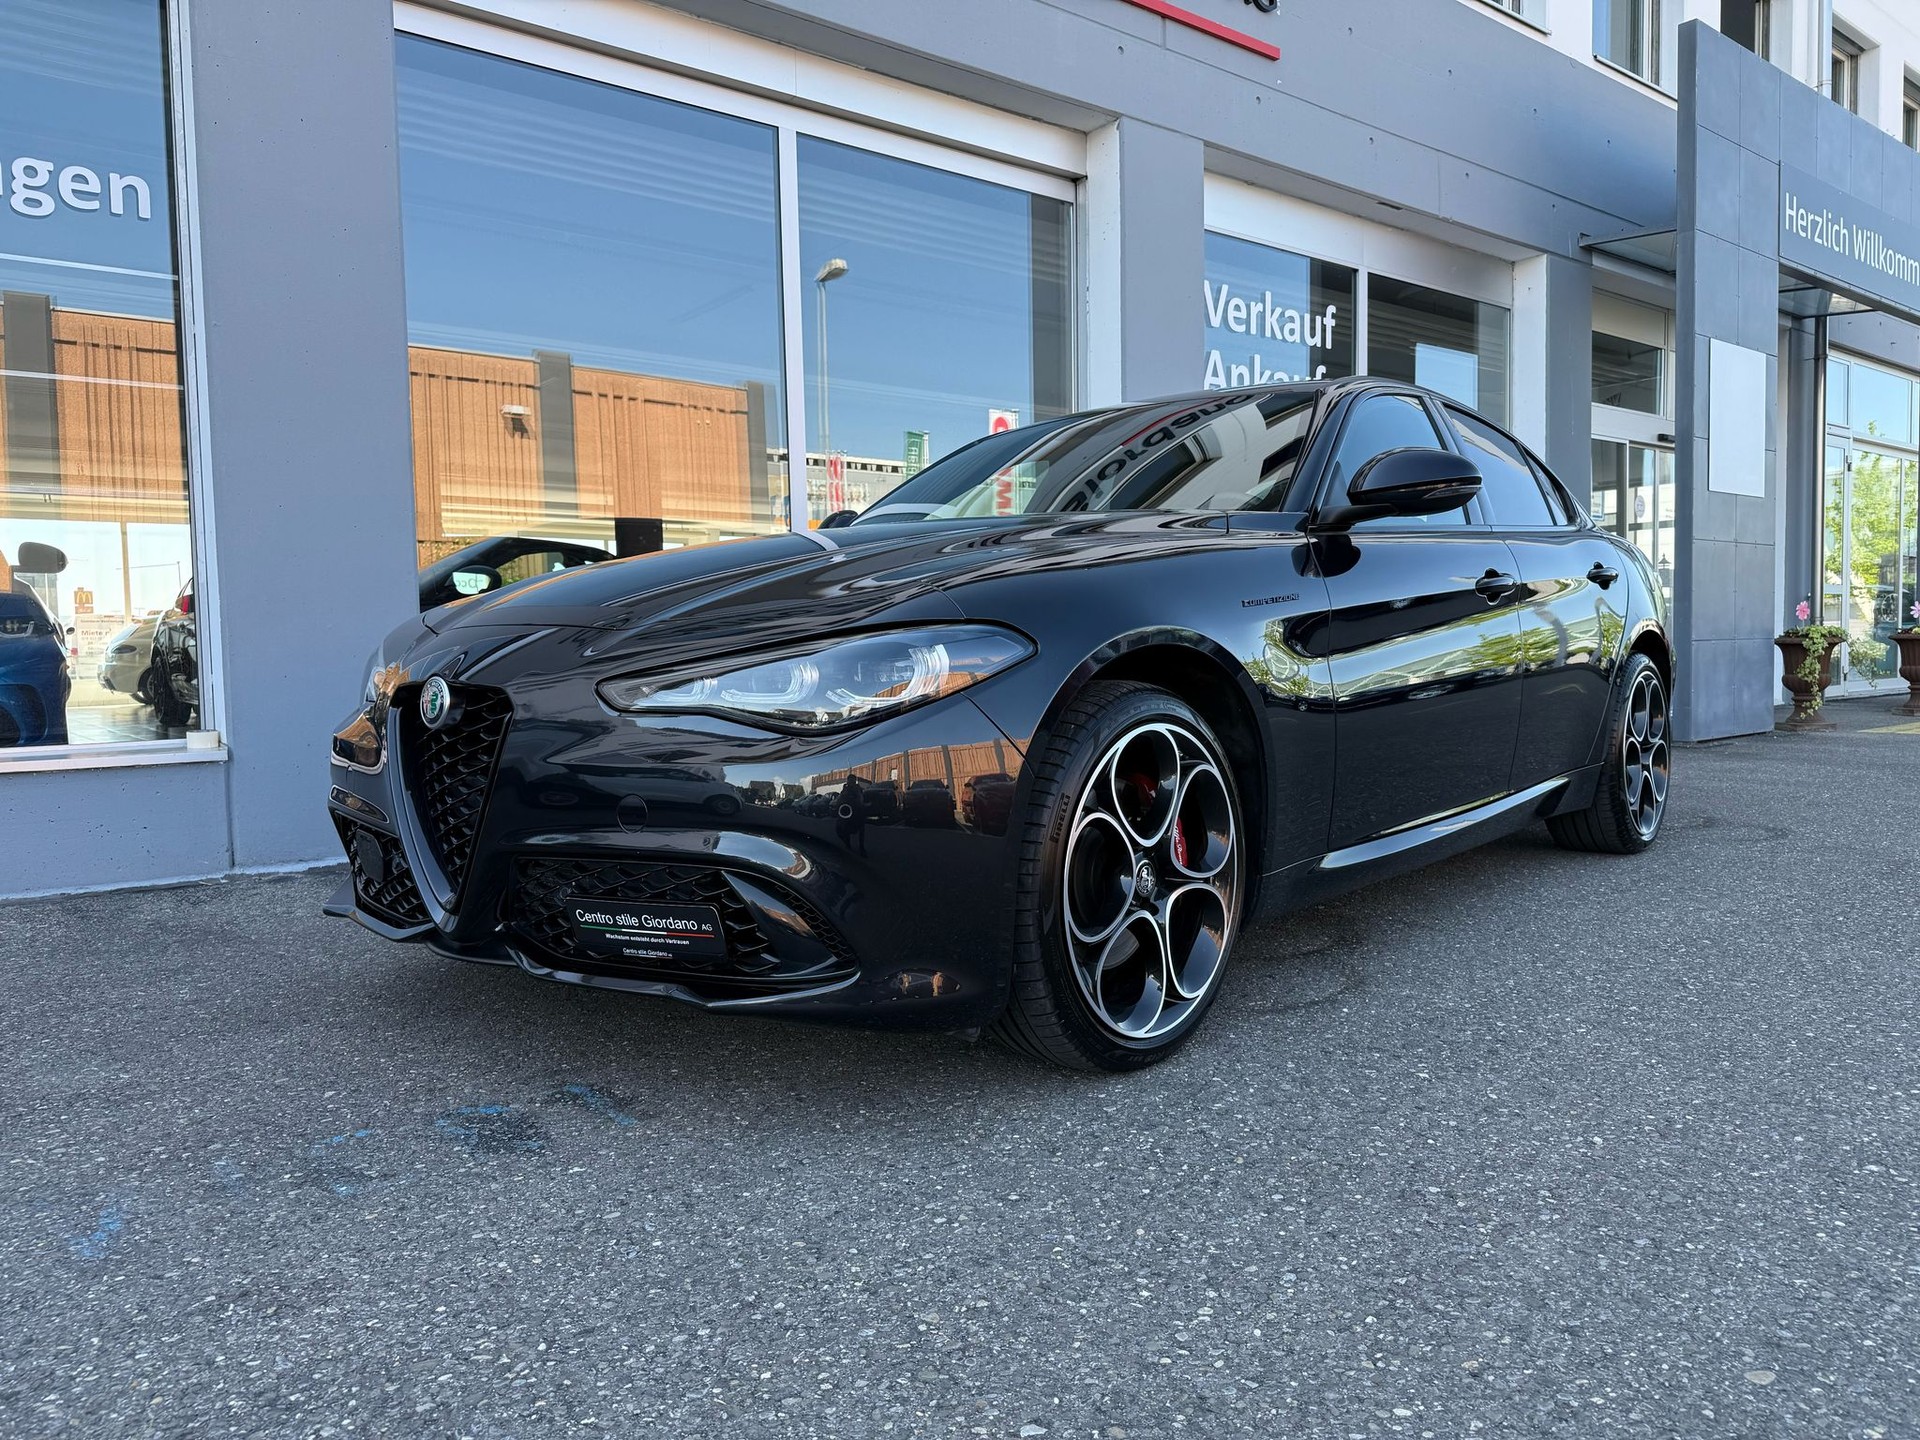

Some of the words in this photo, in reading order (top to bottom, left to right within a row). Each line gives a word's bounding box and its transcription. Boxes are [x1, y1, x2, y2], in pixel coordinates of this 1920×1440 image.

[0, 157, 151, 218] gen
[1785, 192, 1849, 255] Herzlich
[1853, 224, 1920, 286] Willkomm
[1204, 279, 1337, 349] Verkauf
[575, 909, 613, 925] Centro
[615, 913, 639, 926] stile
[641, 914, 698, 931] Giordano
[701, 923, 713, 931] AG
